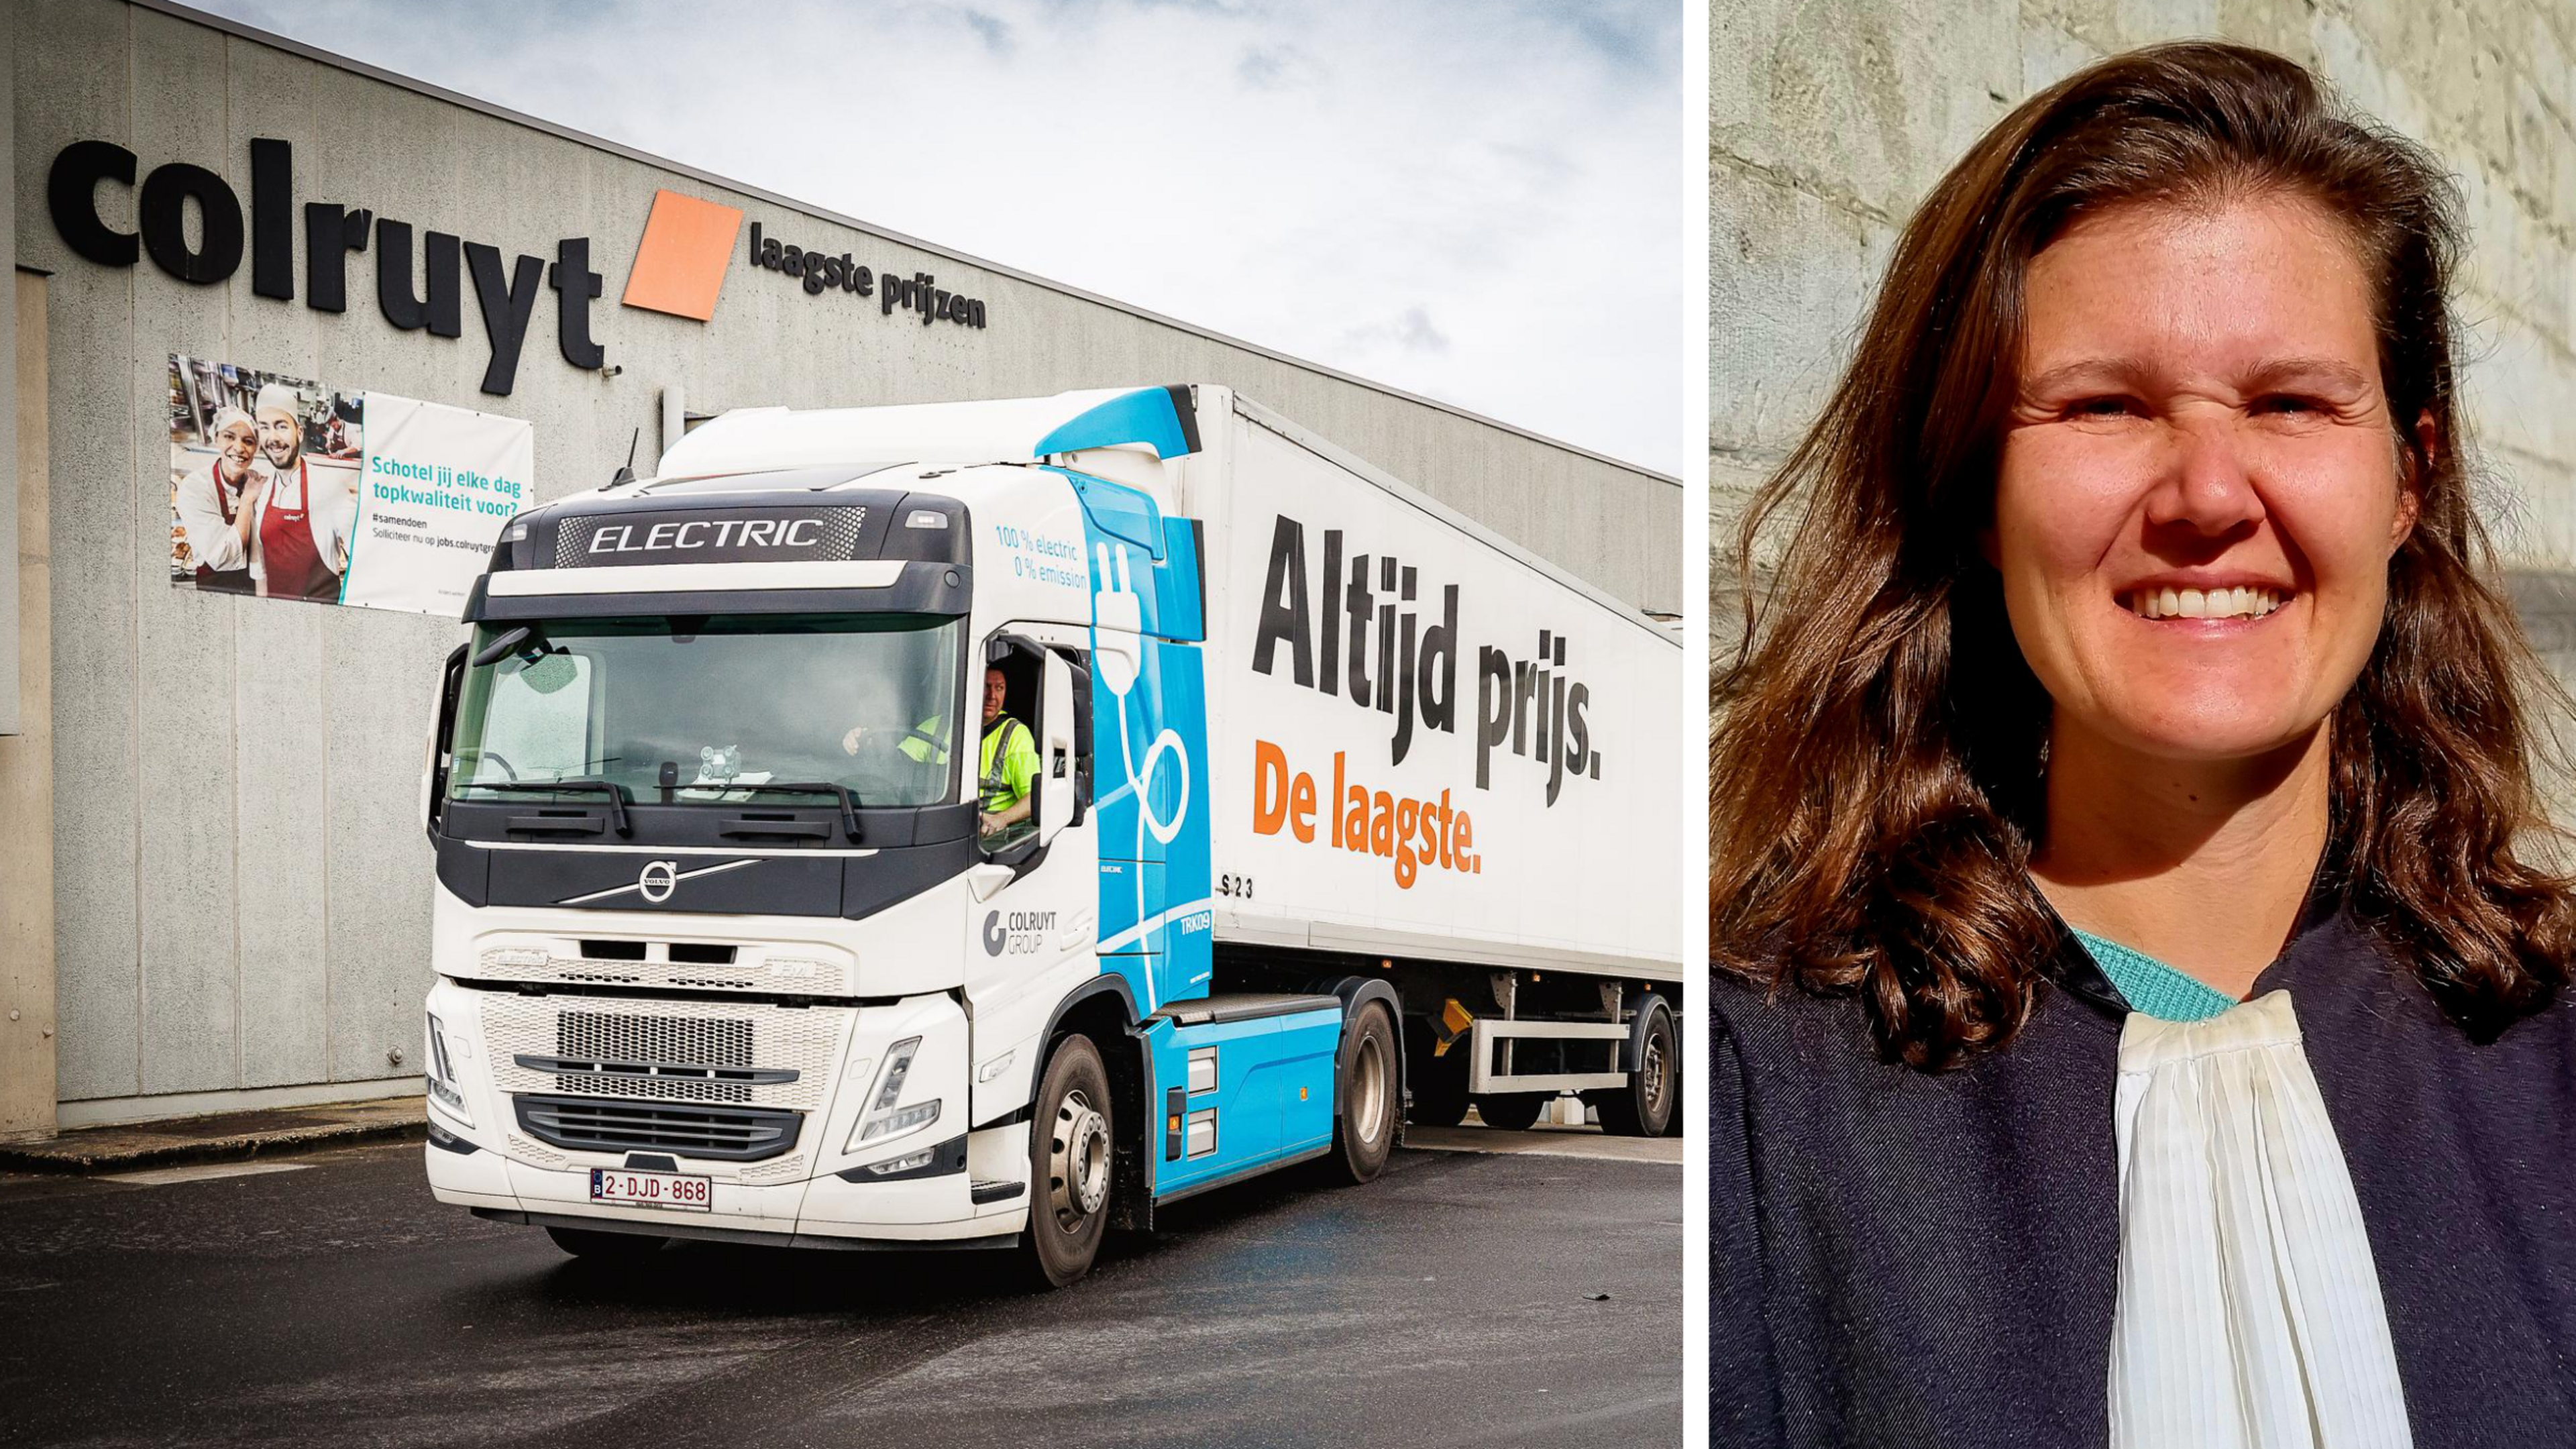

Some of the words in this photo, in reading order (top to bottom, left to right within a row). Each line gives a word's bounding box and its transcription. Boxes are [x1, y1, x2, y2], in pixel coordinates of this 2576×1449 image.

[48, 138, 605, 395] colruyt
[751, 222, 873, 296] laagste
[882, 272, 986, 328] prijzen
[372, 456, 432, 480] Schotel
[437, 466, 451, 488] jij
[457, 472, 488, 490] elke
[494, 477, 521, 498] dag
[374, 482, 472, 511] topkwaliteit
[476, 502, 518, 517] voor?
[373, 513, 427, 529] #samendoen
[373, 528, 411, 541] Solliciteer
[413, 535, 423, 543] nu
[425, 537, 435, 546] op
[588, 519, 823, 553] ELECTRIC
[996, 525, 1019, 548] 100
[1020, 530, 1033, 551] %
[1036, 534, 1077, 561] electric
[1015, 556, 1022, 576] 0
[1024, 557, 1036, 580] %
[1040, 565, 1087, 589] emission
[1252, 514, 1459, 767] Altijd
[1476, 629, 1601, 808] prijs.
[1253, 740, 1317, 843] De
[1332, 751, 1481, 889] laagste.
[1008, 912, 1057, 931] COLRUYT
[1181, 912, 1210, 935] TRK09
[1008, 934, 1043, 955] GROUP
[594, 1185, 601, 1193] B
[605, 1175, 706, 1201] 2-DJD-868
